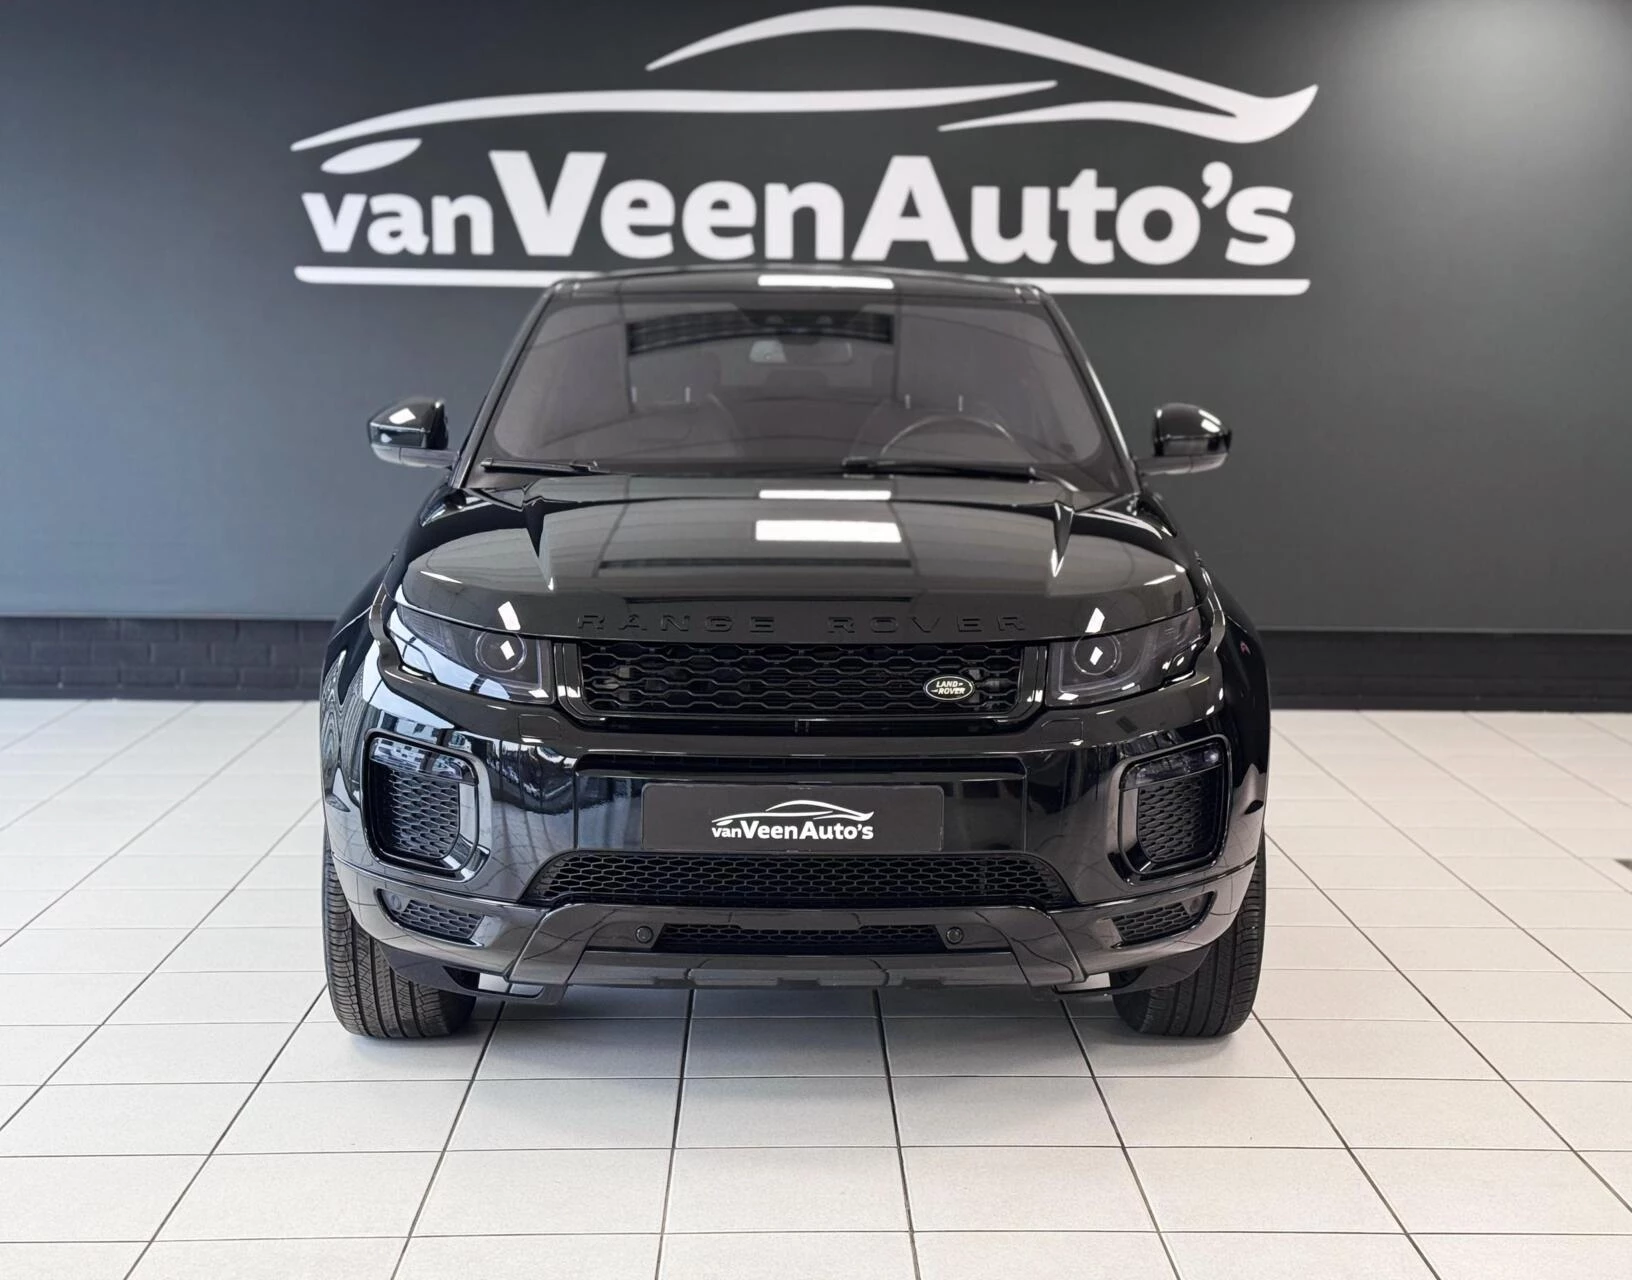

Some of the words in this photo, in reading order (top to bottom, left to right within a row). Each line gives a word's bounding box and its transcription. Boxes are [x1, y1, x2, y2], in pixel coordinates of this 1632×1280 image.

[577, 613, 776, 633] RANGE
[827, 615, 1026, 634] ROVER
[936, 680, 959, 688] LAND
[937, 687, 966, 695] ROVER
